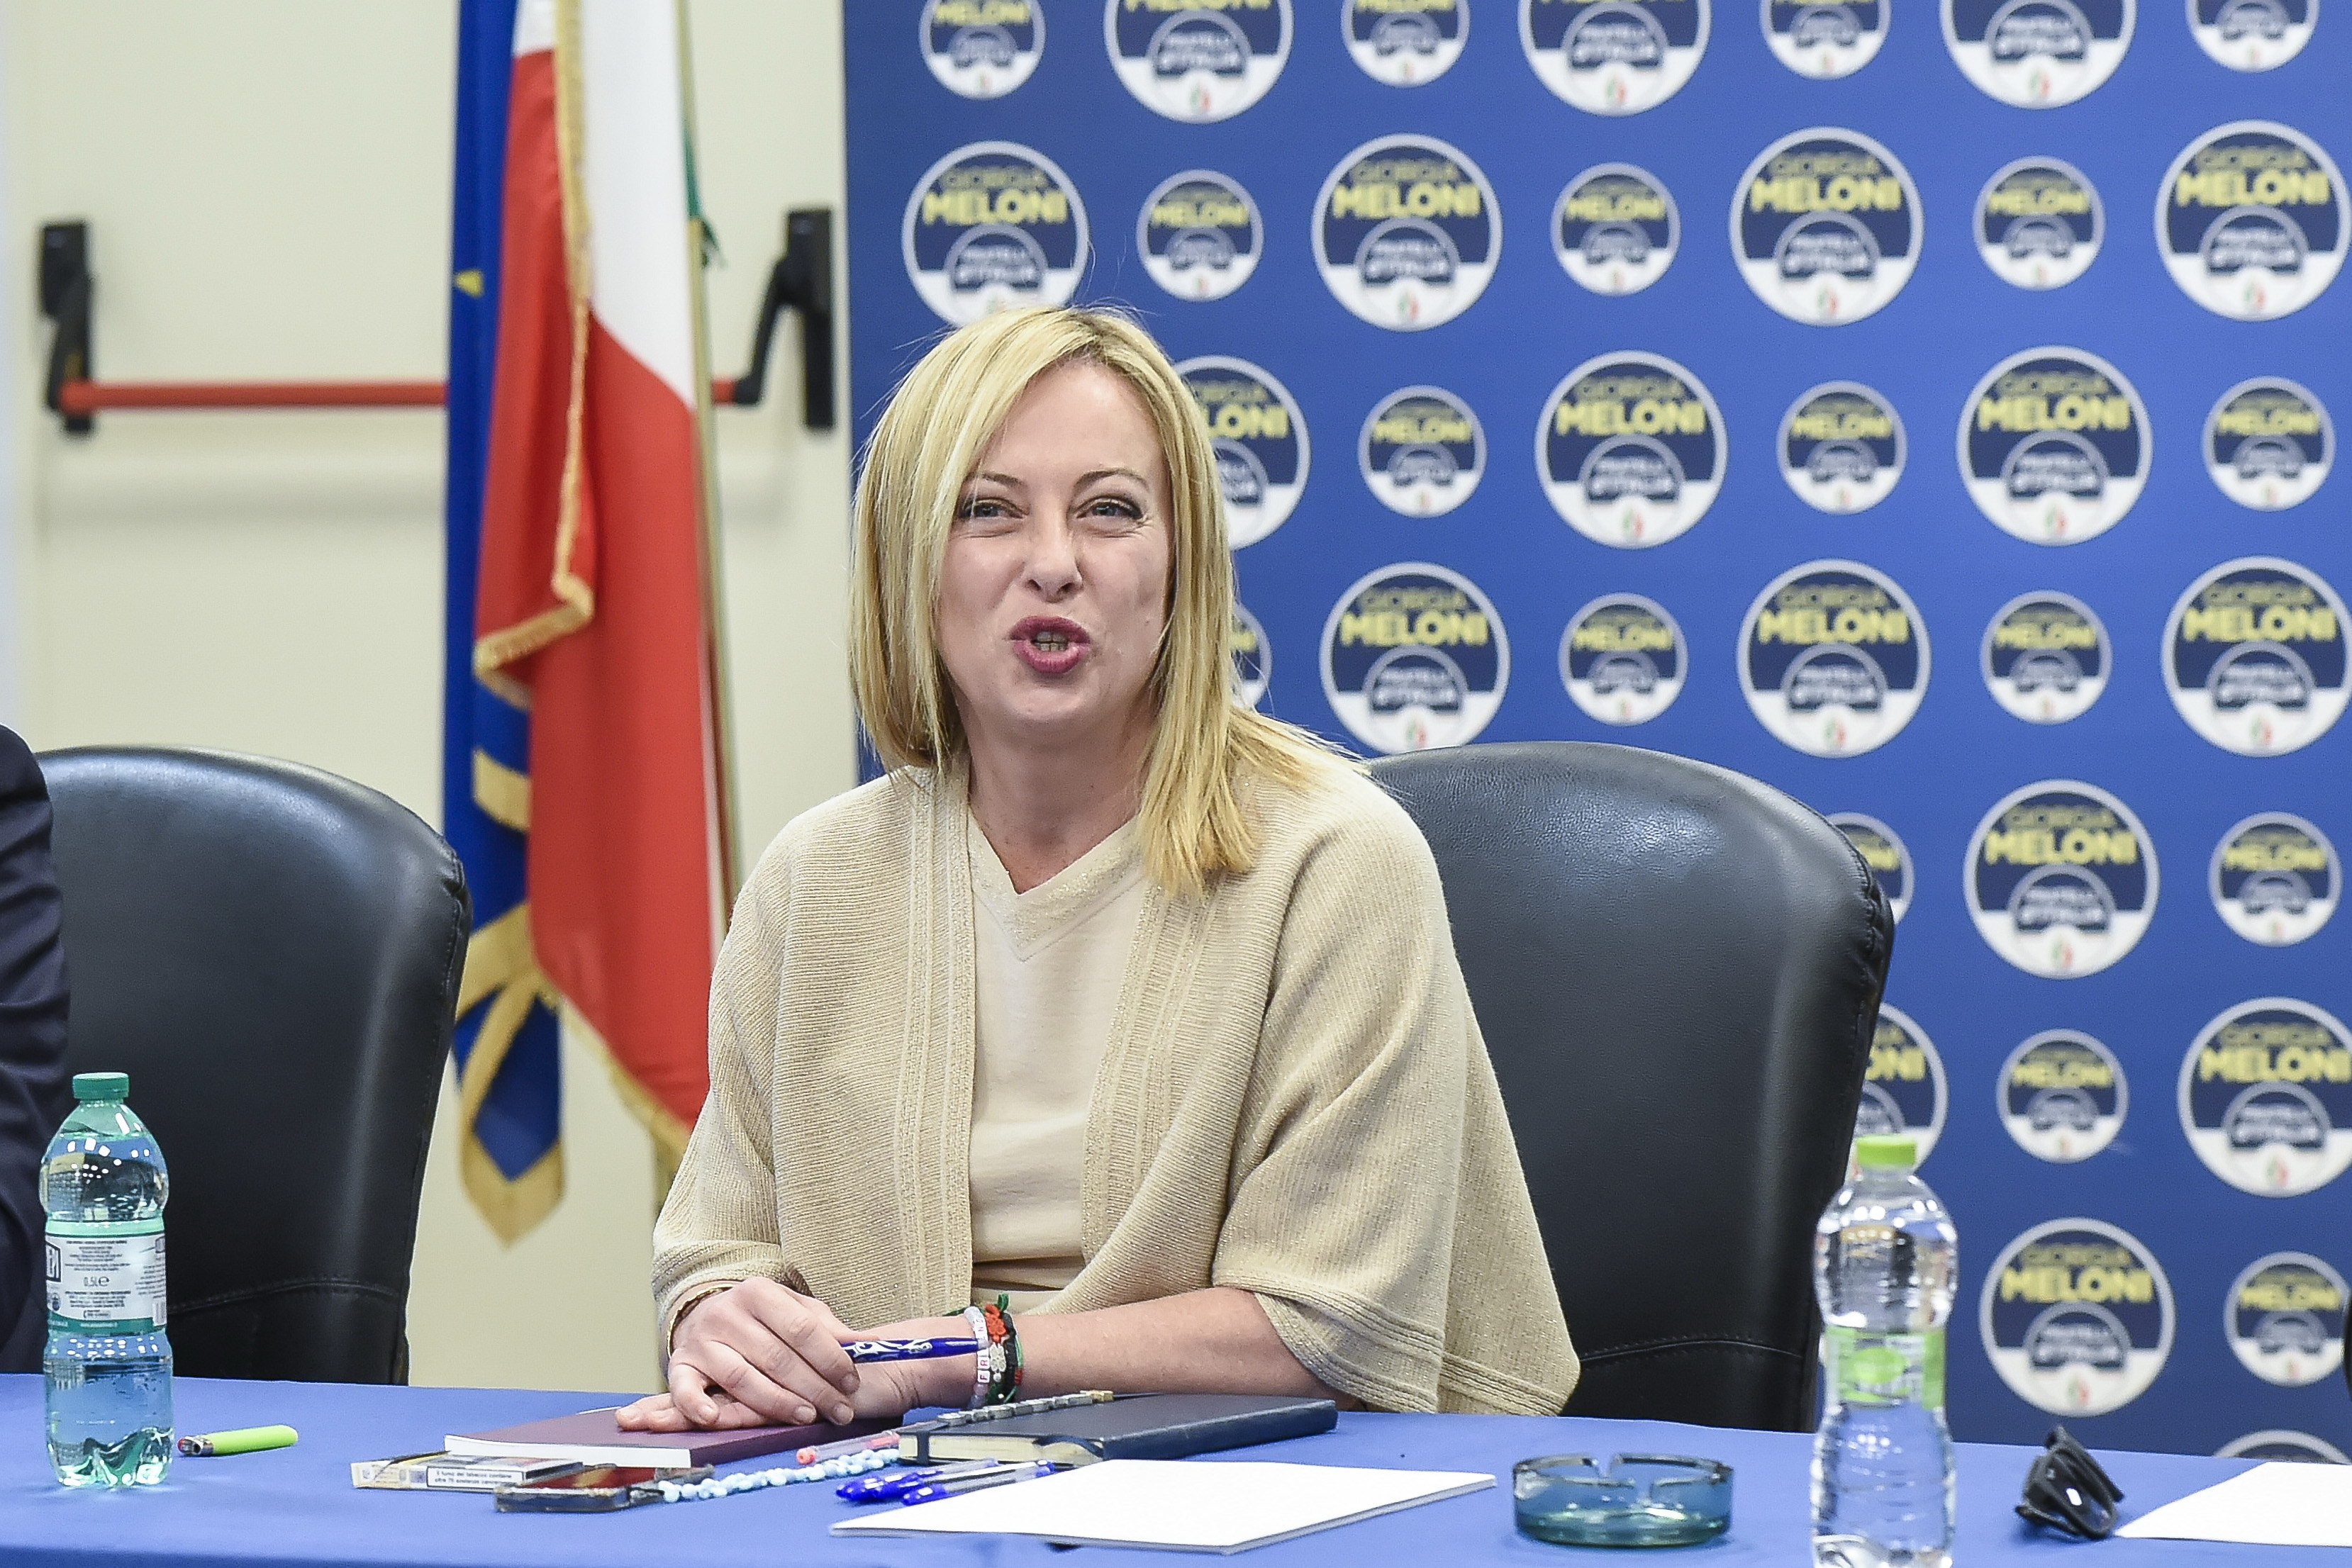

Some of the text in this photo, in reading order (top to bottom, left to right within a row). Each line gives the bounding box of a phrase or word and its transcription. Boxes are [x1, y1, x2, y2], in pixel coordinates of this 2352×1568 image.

[1334, 181, 1481, 218] MELONI
[1751, 175, 1902, 212] MELONI
[2176, 169, 2330, 206] MELONI
[923, 188, 1067, 225] MELONI
[1557, 398, 1707, 435] MELONI
[1978, 394, 2131, 431] MELONI
[1340, 610, 1488, 646] MELONI
[1759, 607, 1909, 644] MELONI
[2183, 605, 2337, 642] MELONI
[1985, 828, 2137, 865] MELONI
[2200, 1046, 2352, 1082] MELONI
[2000, 1266, 2153, 1303] MELONI
